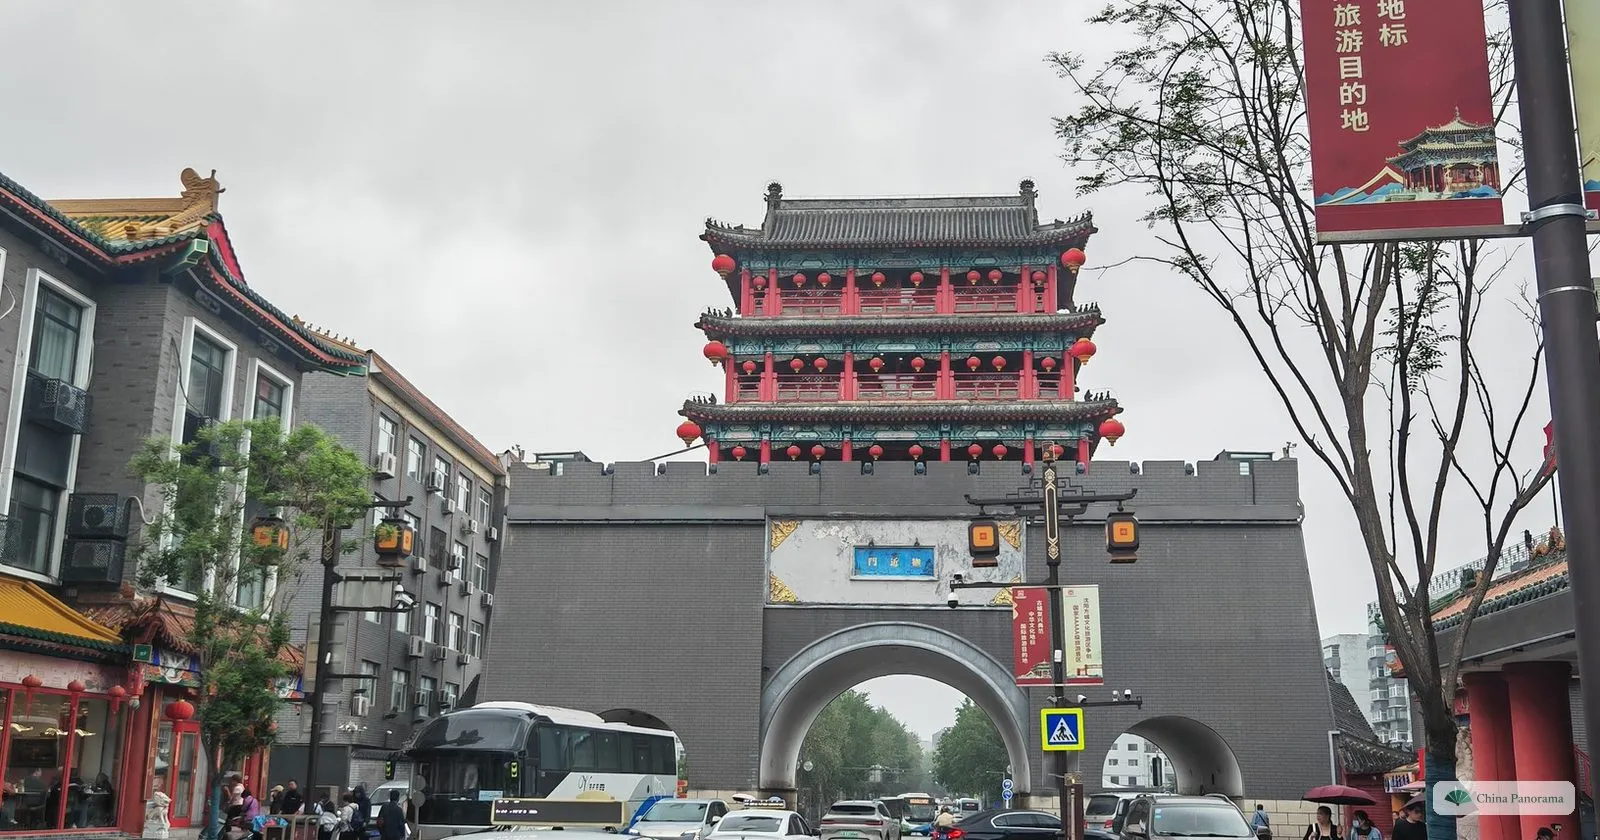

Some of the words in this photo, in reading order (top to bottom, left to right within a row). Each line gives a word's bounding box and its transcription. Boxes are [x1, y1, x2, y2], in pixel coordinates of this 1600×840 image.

[1377, 0, 1408, 47] 地标
[1333, 0, 1370, 132] 旅游目的地
[1020, 623, 1028, 664] 国际旅游目的地
[1028, 611, 1036, 646] 中华文化地标
